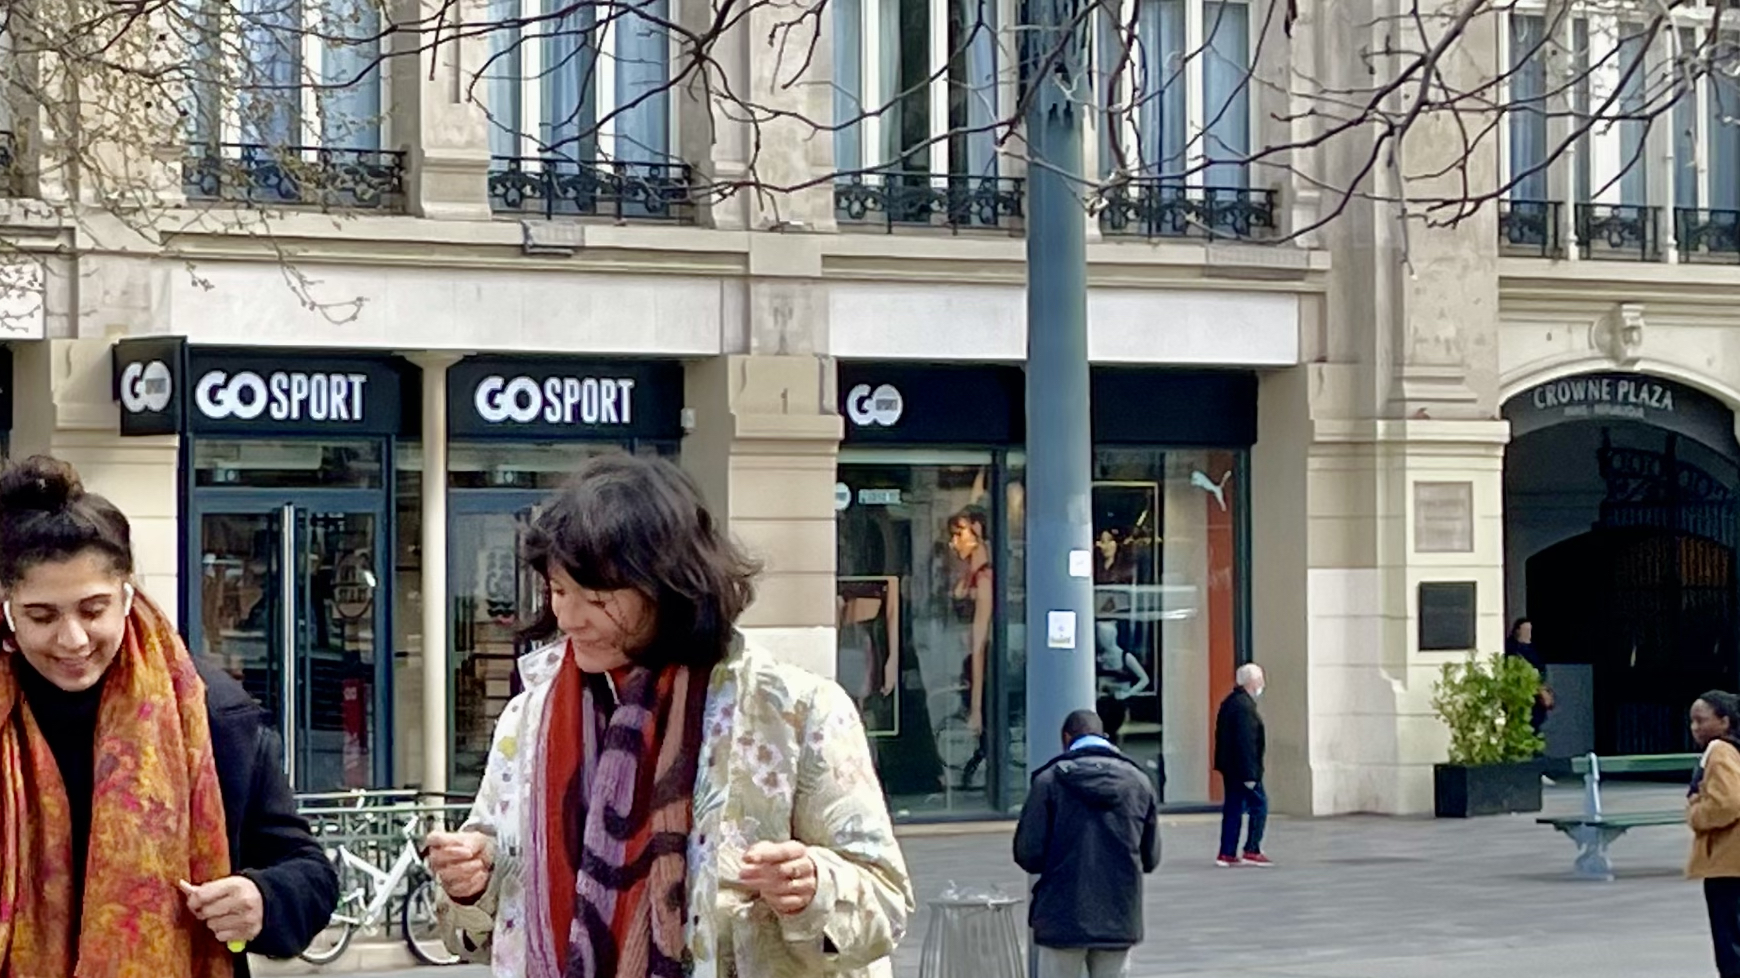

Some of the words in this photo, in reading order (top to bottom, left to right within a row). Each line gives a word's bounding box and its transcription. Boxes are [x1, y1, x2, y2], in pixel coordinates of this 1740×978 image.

[121, 361, 172, 413] GO
[195, 370, 269, 420] GO
[269, 371, 367, 421] SPORT
[474, 375, 543, 423] GO
[543, 376, 635, 424] SPORT
[847, 384, 903, 427] GO
[1533, 378, 1611, 410] CROWNE
[1617, 379, 1674, 411] PLAZA
